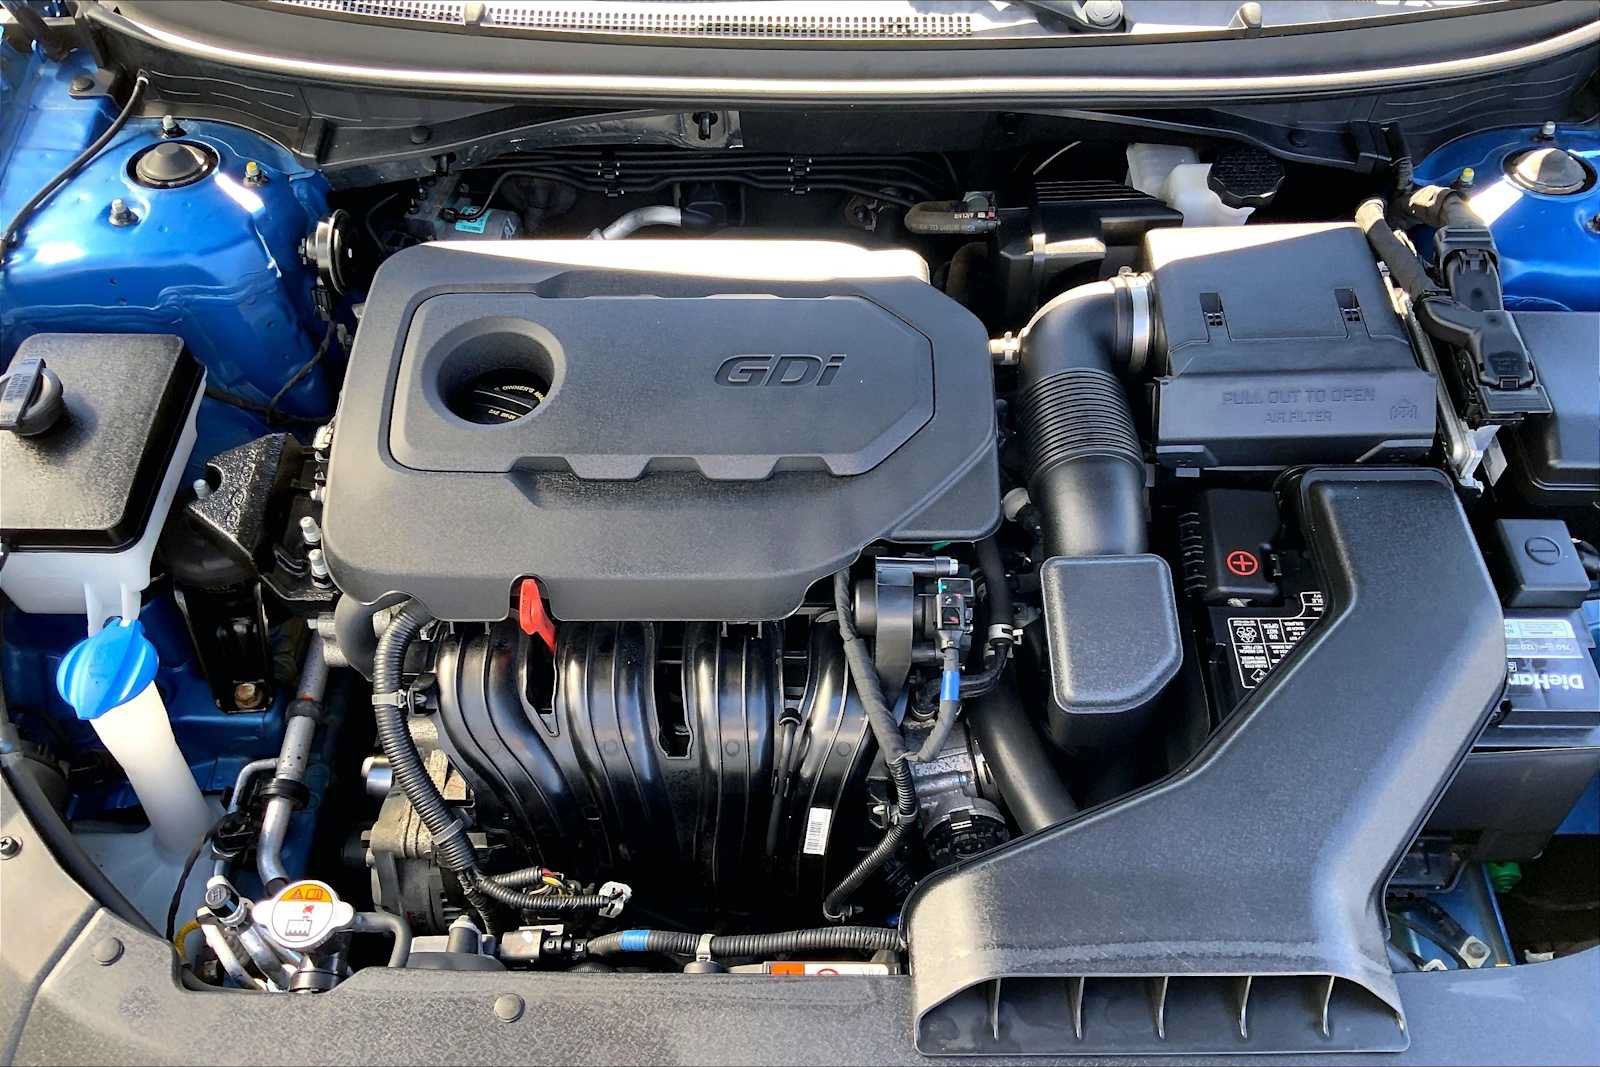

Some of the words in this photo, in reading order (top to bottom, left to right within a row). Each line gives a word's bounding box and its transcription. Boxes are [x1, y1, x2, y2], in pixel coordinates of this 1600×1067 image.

[712, 353, 847, 387] GDi
[1222, 391, 1263, 405] PULL
[1268, 389, 1301, 404] OUT
[1305, 388, 1326, 403] TO
[1331, 387, 1375, 402] OPEN
[1263, 411, 1286, 424] AIR
[1290, 410, 1333, 423] FILTER
[1508, 673, 1585, 689] DieHar
